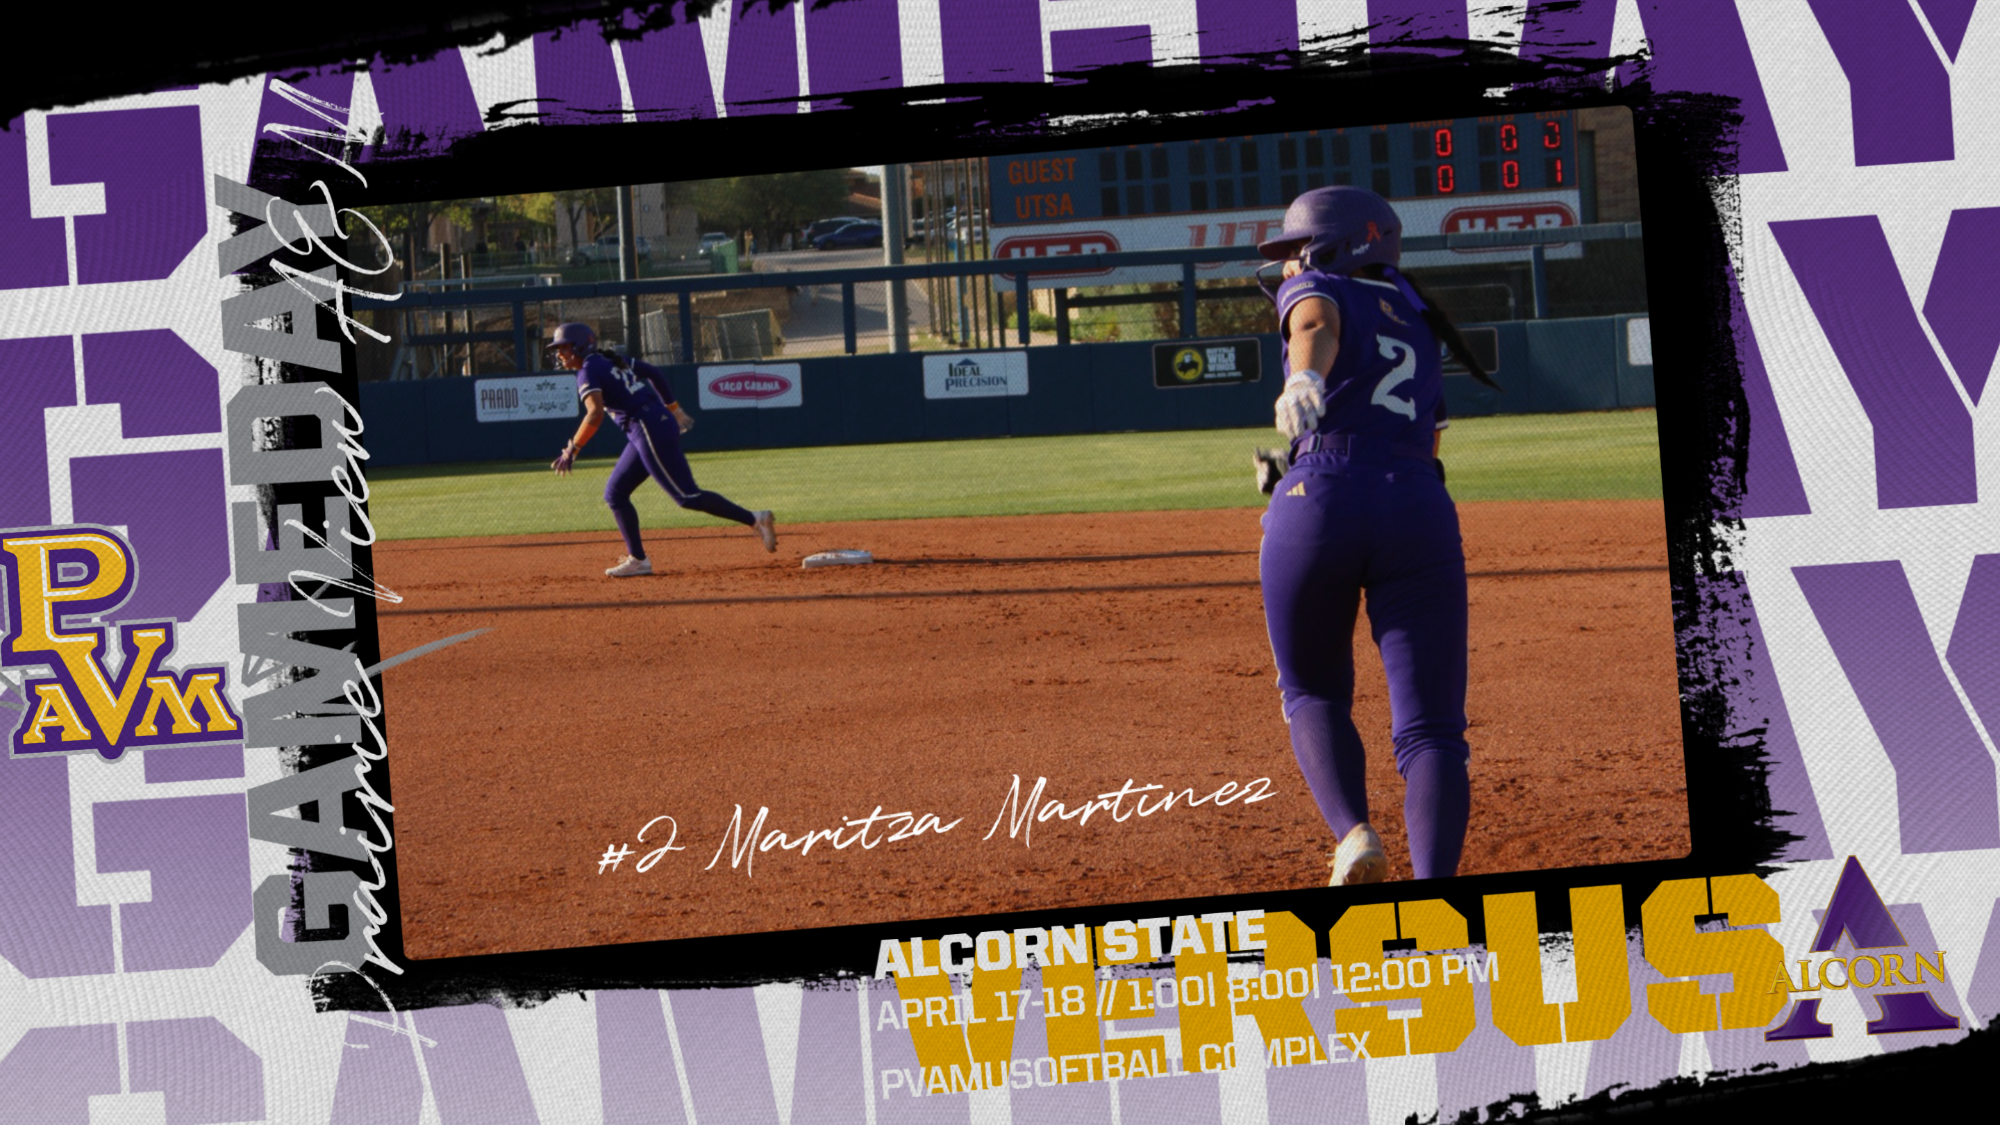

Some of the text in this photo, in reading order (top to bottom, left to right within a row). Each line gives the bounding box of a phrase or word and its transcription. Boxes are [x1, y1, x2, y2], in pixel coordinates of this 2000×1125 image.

[1435, 128, 1452, 157] 0
[1008, 157, 1076, 186] GUEST
[1437, 165, 1453, 192] 0
[1015, 193, 1074, 219] UTSA
[718, 380, 780, 392] TACO CABANA
[945, 376, 1008, 391] PRECISION
[1370, 333, 1416, 421] 2
[481, 388, 519, 410] PRADO
